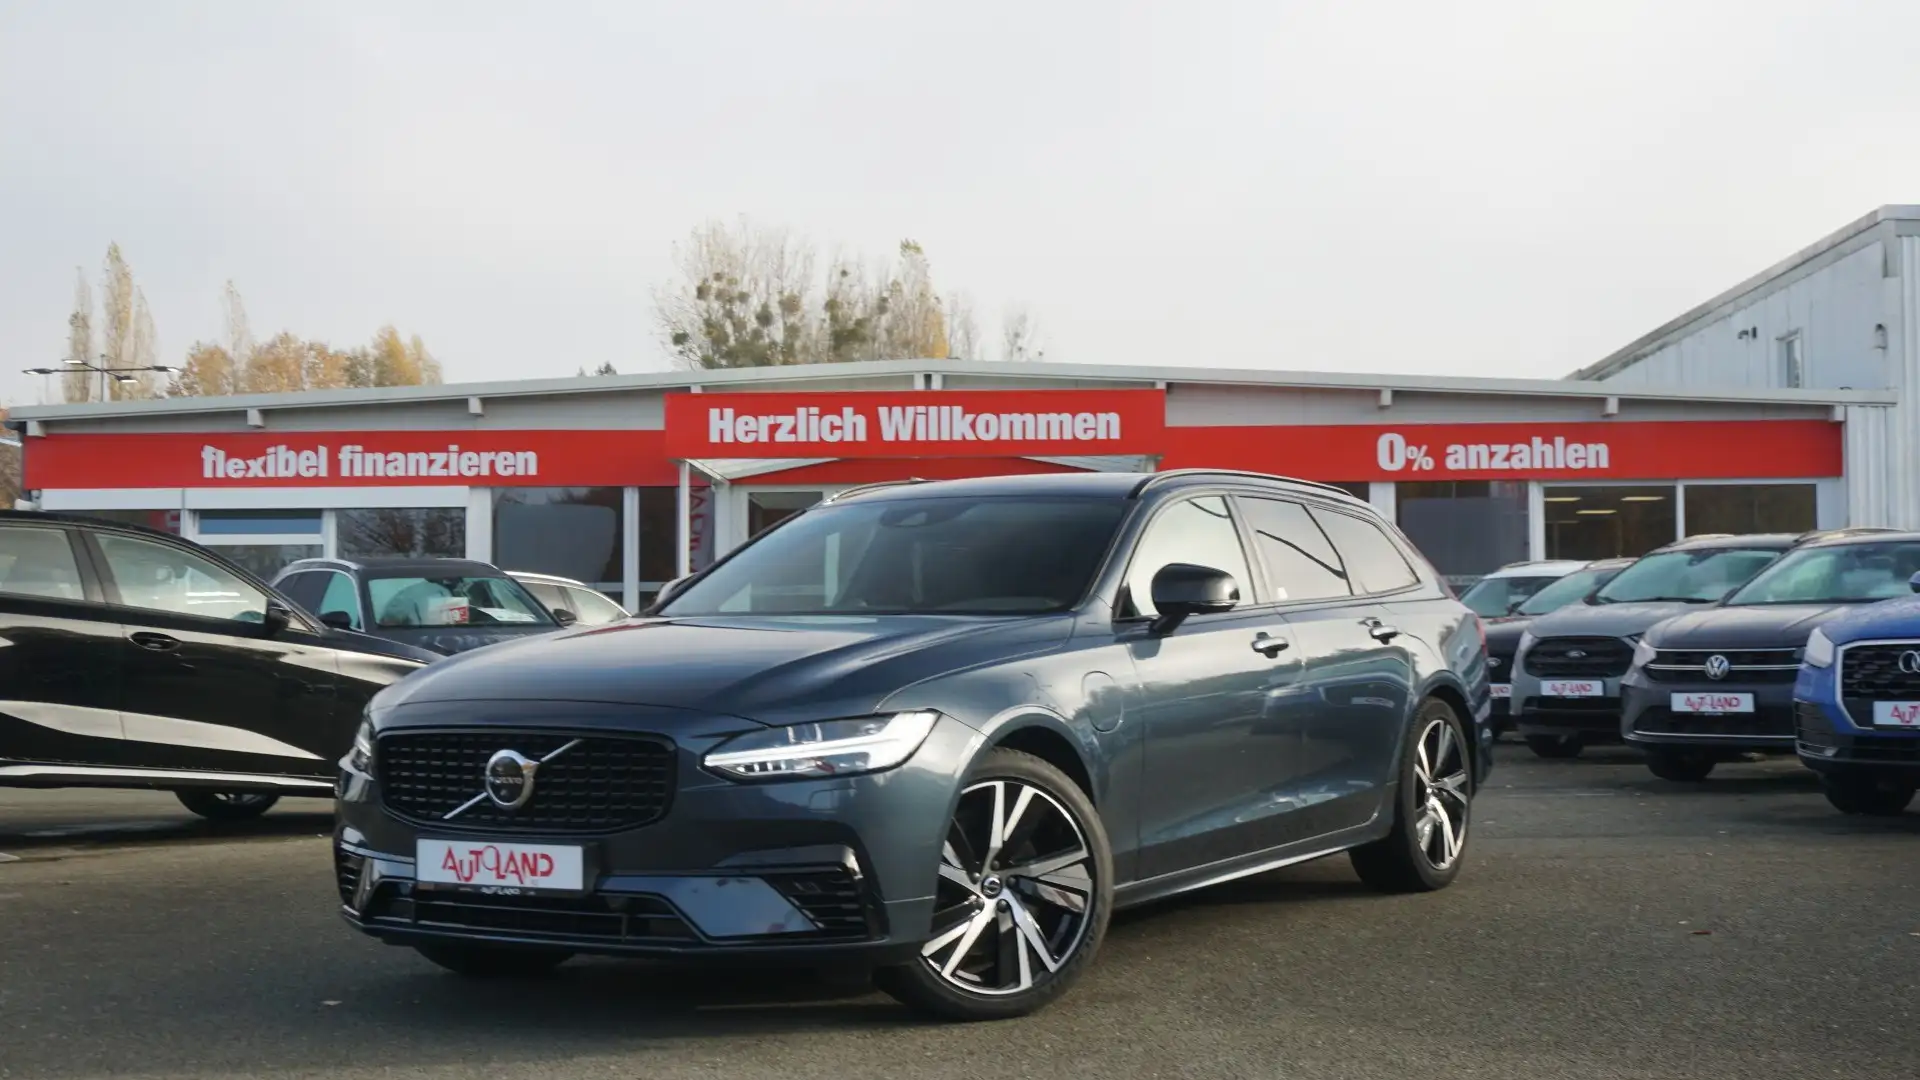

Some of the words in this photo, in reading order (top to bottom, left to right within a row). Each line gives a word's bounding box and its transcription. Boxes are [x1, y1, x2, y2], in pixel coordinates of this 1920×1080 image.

[708, 407, 866, 443] Herzlich
[878, 406, 1121, 442] Willkommen
[201, 445, 328, 478] flexibel
[338, 444, 538, 477] finanzieren
[1377, 433, 1435, 471] 0%
[1446, 437, 1610, 470] anzahlen
[1891, 704, 1920, 725] AUT
[442, 845, 555, 885] AUTOLAND
